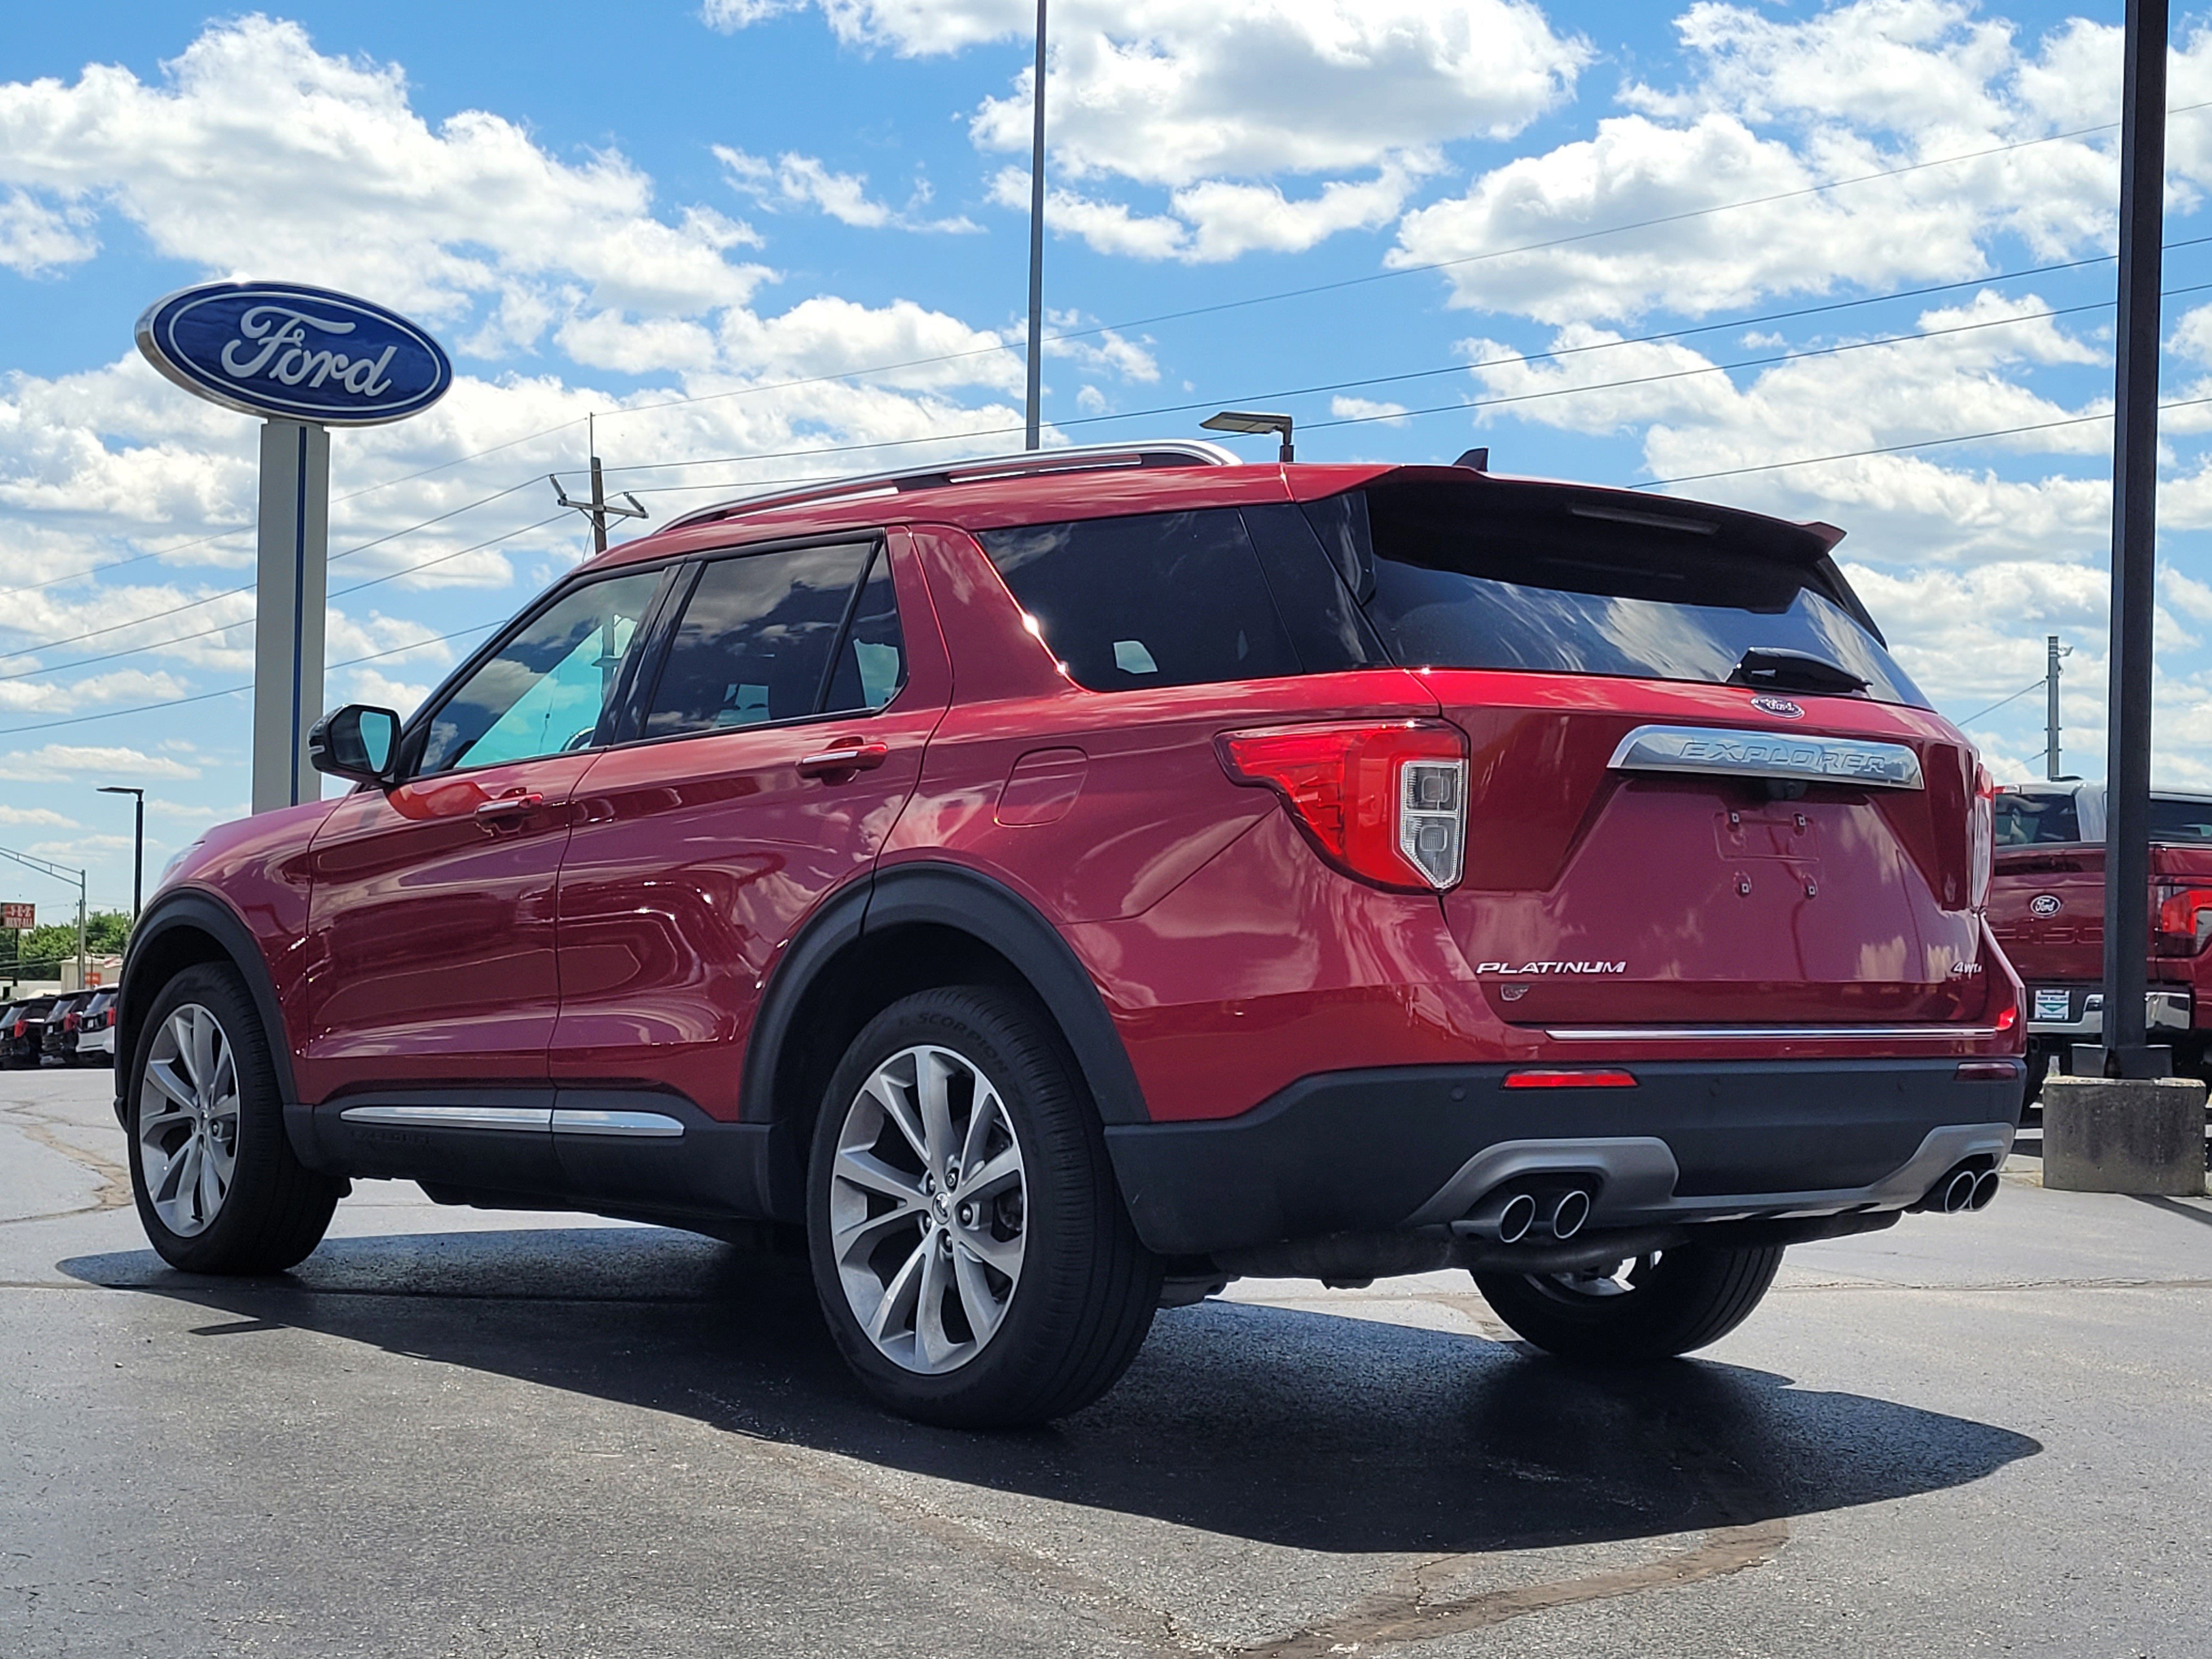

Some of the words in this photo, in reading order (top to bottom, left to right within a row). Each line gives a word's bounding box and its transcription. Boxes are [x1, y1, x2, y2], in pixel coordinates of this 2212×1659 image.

[221, 306, 398, 397] Ford
[1680, 741, 1886, 774] EXPLORER
[2035, 899, 2056, 912] Ford
[1476, 962, 1626, 974] PLATINUM
[918, 1013, 1009, 1073] SCORPION
